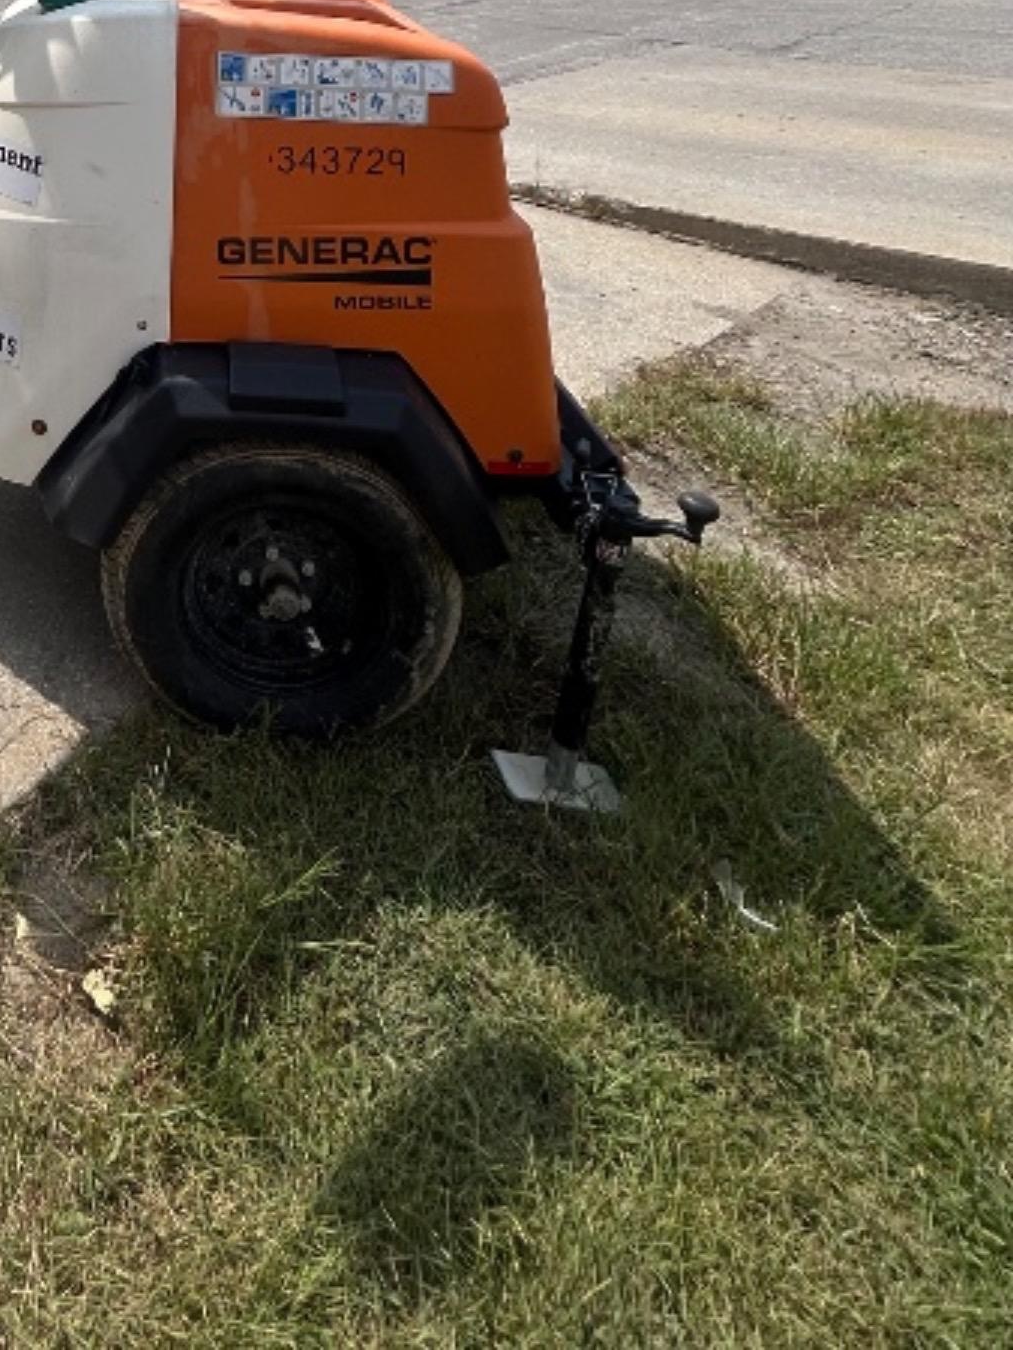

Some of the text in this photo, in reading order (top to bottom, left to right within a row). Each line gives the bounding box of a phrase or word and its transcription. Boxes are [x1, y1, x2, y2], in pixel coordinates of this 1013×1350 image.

[277, 147, 406, 176] 343729
[217, 236, 432, 266] GENERAC
[334, 296, 432, 310] MOBILE
